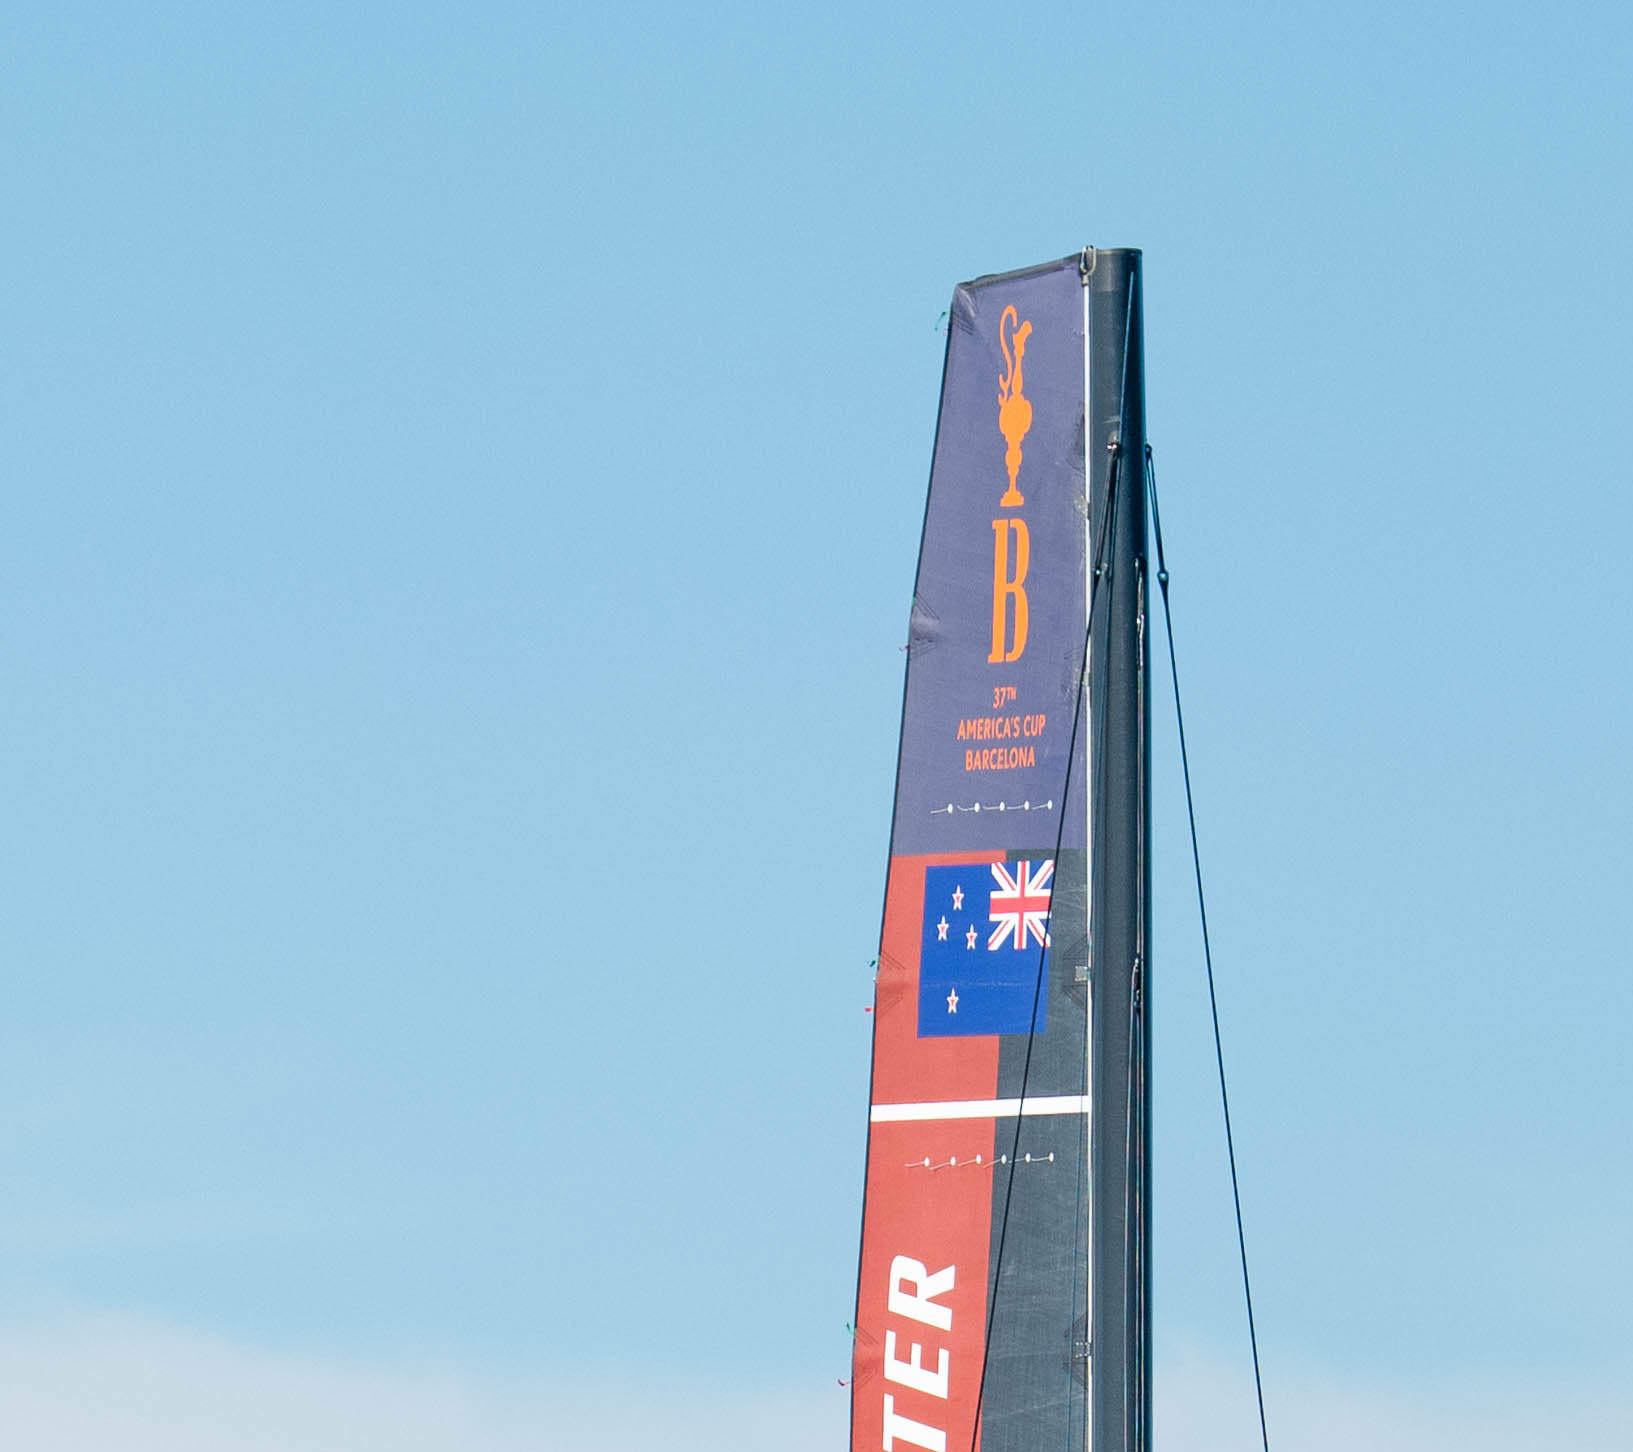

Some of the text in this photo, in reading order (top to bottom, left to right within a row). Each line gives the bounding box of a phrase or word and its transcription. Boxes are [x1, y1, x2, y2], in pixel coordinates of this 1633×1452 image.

[992, 686, 1017, 708] 37TH
[956, 713, 1047, 741] AMERICA'S CUP
[965, 745, 1035, 772] BARCELONA
